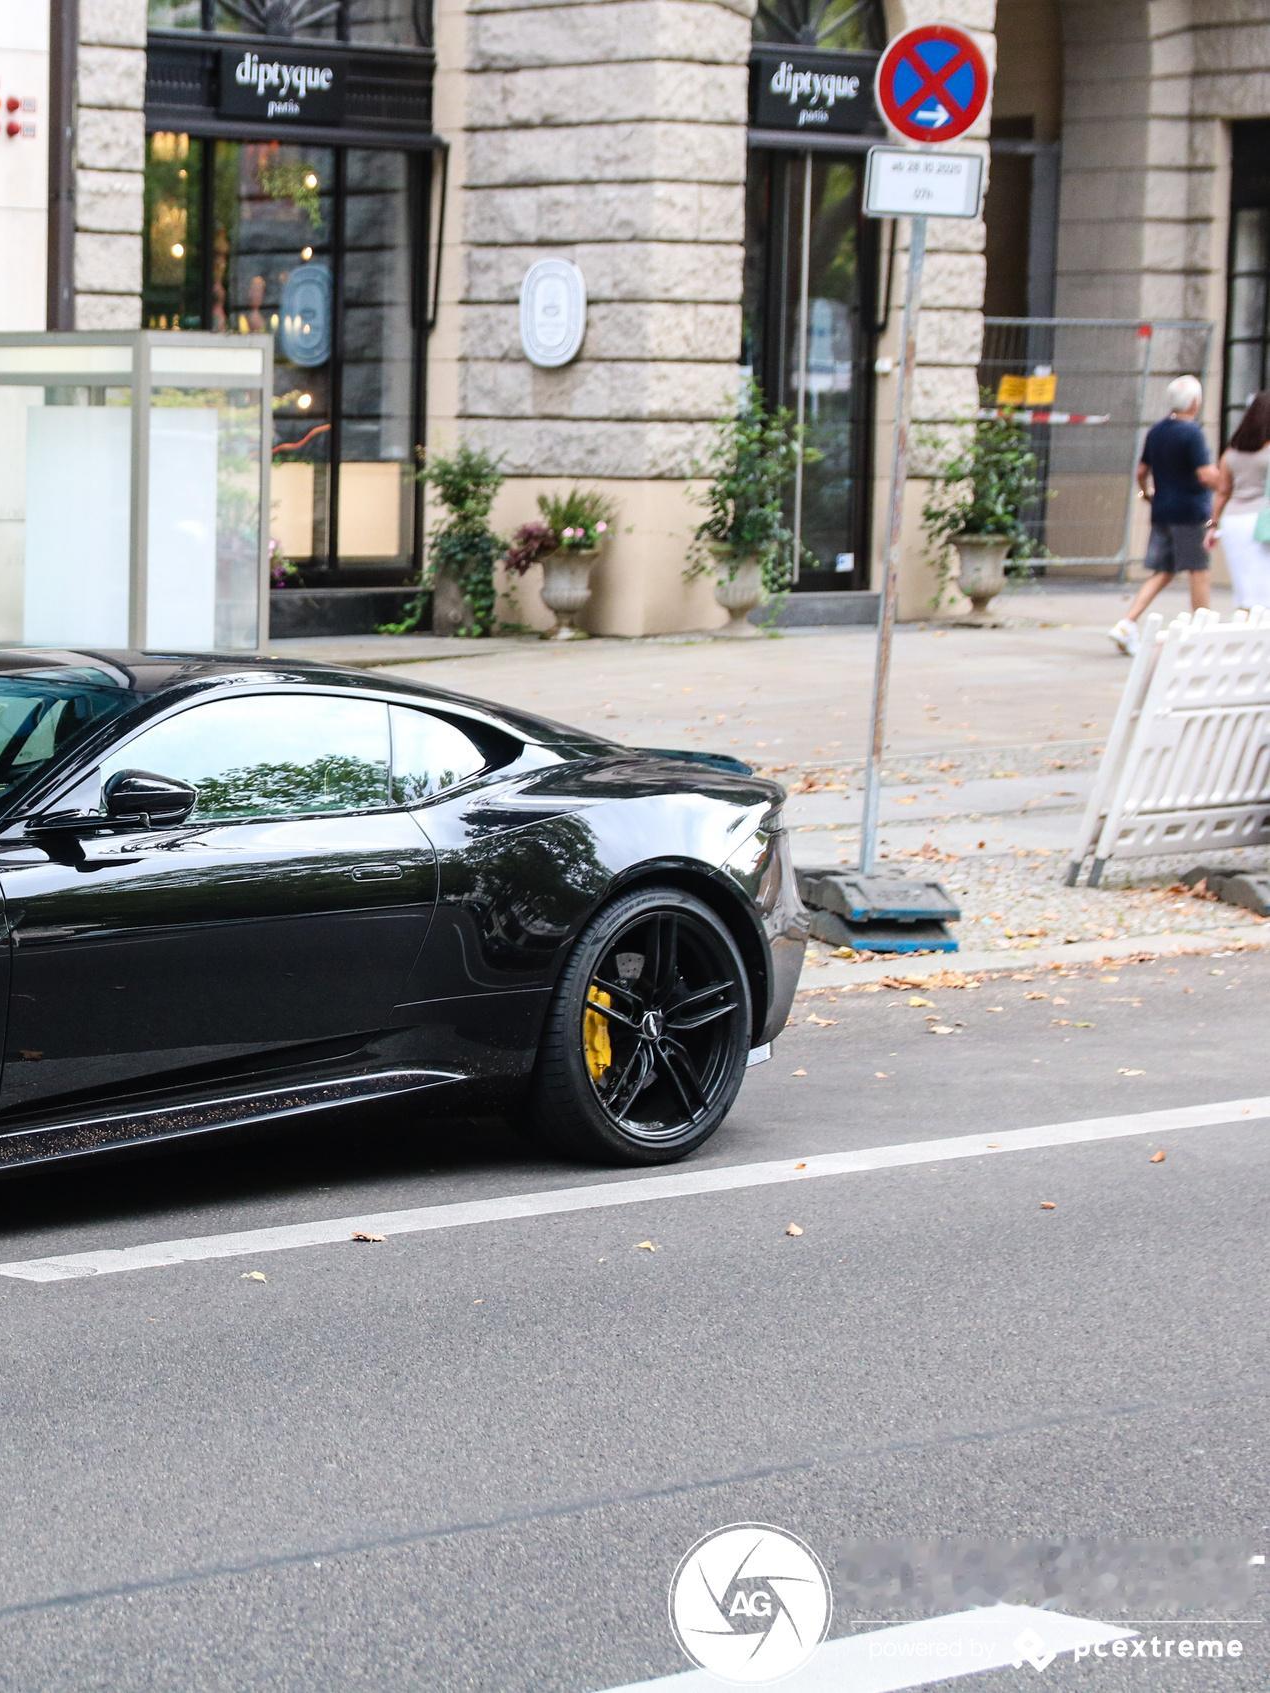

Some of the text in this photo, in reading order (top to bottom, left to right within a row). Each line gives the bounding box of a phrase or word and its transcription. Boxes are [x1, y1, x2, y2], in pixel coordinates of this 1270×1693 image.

[235, 52, 333, 98] diptyque
[771, 61, 860, 107] diptyque
[267, 99, 300, 118] paris
